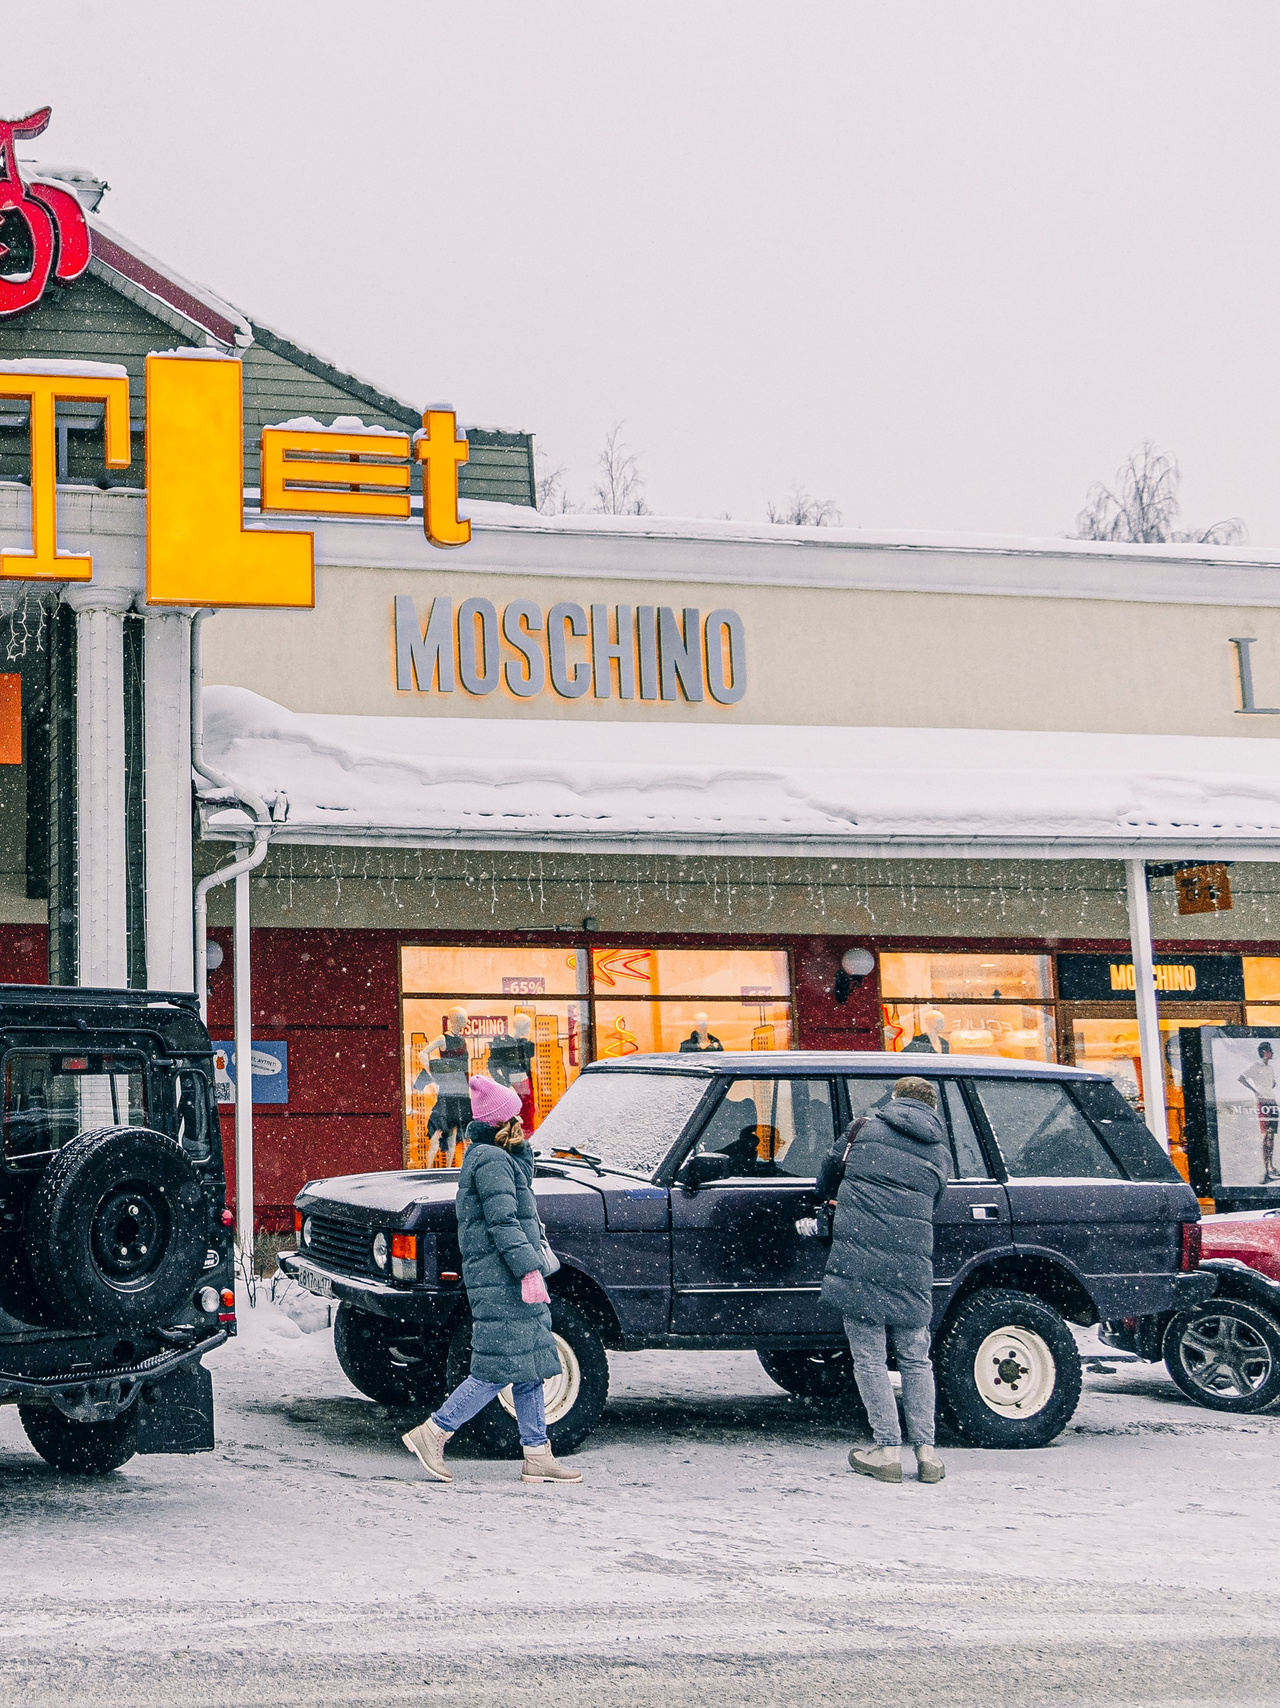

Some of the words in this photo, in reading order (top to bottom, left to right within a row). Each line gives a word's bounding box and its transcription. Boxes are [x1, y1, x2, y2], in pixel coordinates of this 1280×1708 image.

[394, 595, 747, 705] MOSCHINO
[504, 981, 544, 994] -65%
[1109, 964, 1197, 991] MOCHINO
[447, 1018, 505, 1035] SCHINO
